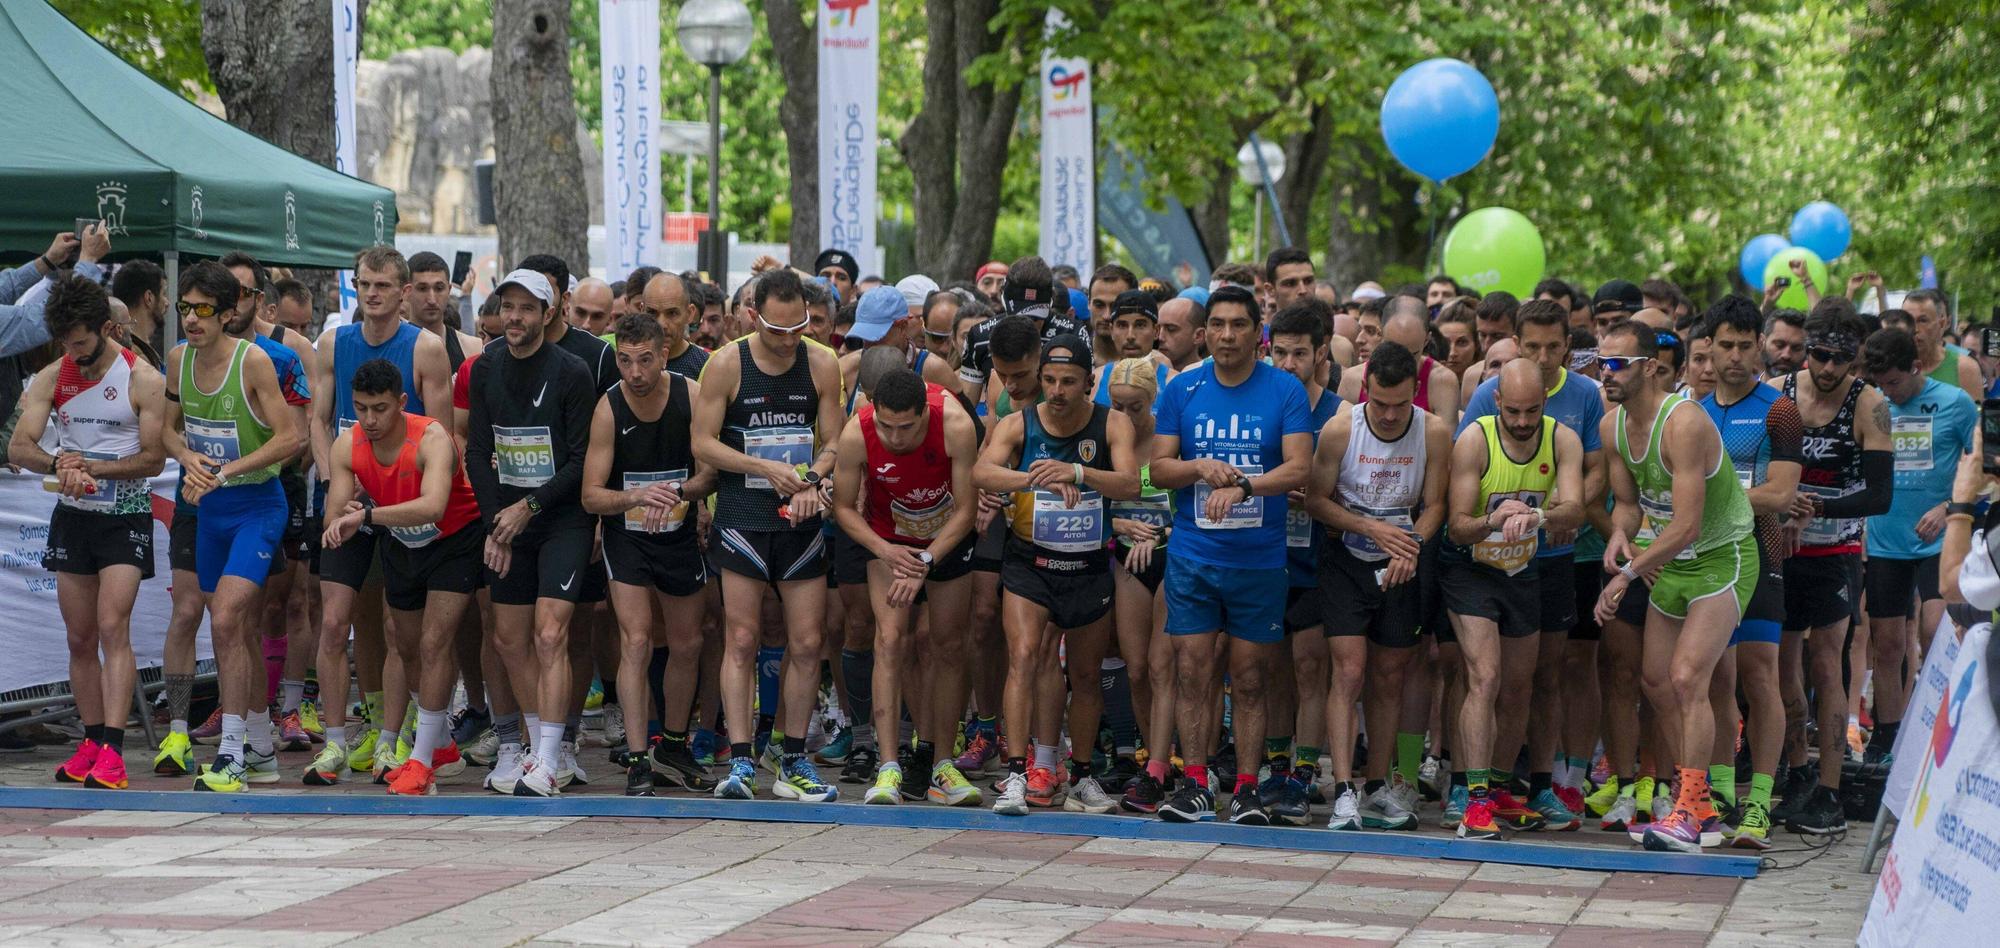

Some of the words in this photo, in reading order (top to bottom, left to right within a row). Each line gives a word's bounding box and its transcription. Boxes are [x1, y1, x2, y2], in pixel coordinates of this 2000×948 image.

[73, 416, 94, 426] super
[97, 418, 121, 427] amara
[749, 411, 806, 427] Alimco
[203, 441, 225, 458] 30
[1895, 436, 1930, 451] 832
[505, 450, 550, 467] 1905
[1355, 483, 1409, 496] Huesca
[1055, 515, 1094, 532] 229
[1063, 531, 1087, 539] AITOR
[1489, 541, 1536, 561] 3001
